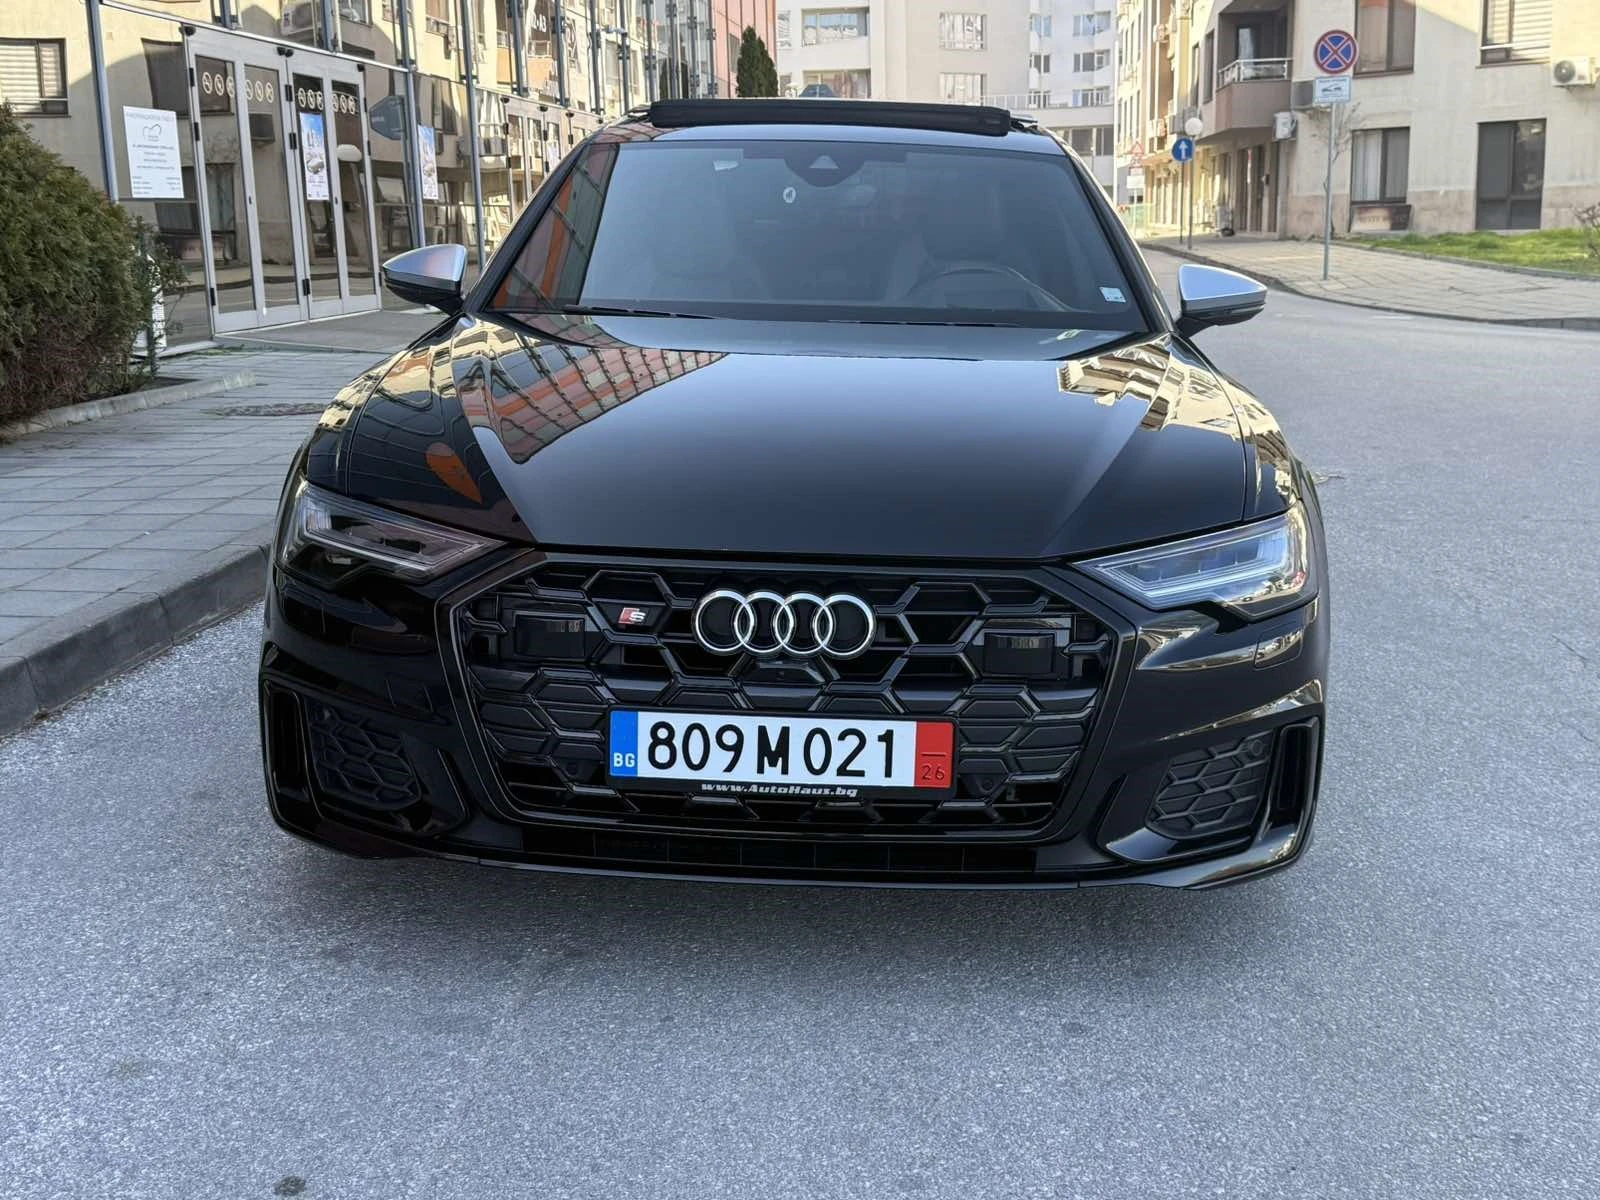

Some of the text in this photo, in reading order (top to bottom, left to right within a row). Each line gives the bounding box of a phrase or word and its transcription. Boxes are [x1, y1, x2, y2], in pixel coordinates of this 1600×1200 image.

[648, 720, 894, 778] 809 M 021
[613, 752, 636, 768] BG
[921, 764, 945, 781] 26
[701, 783, 858, 798] www.AutoHaus.bg
